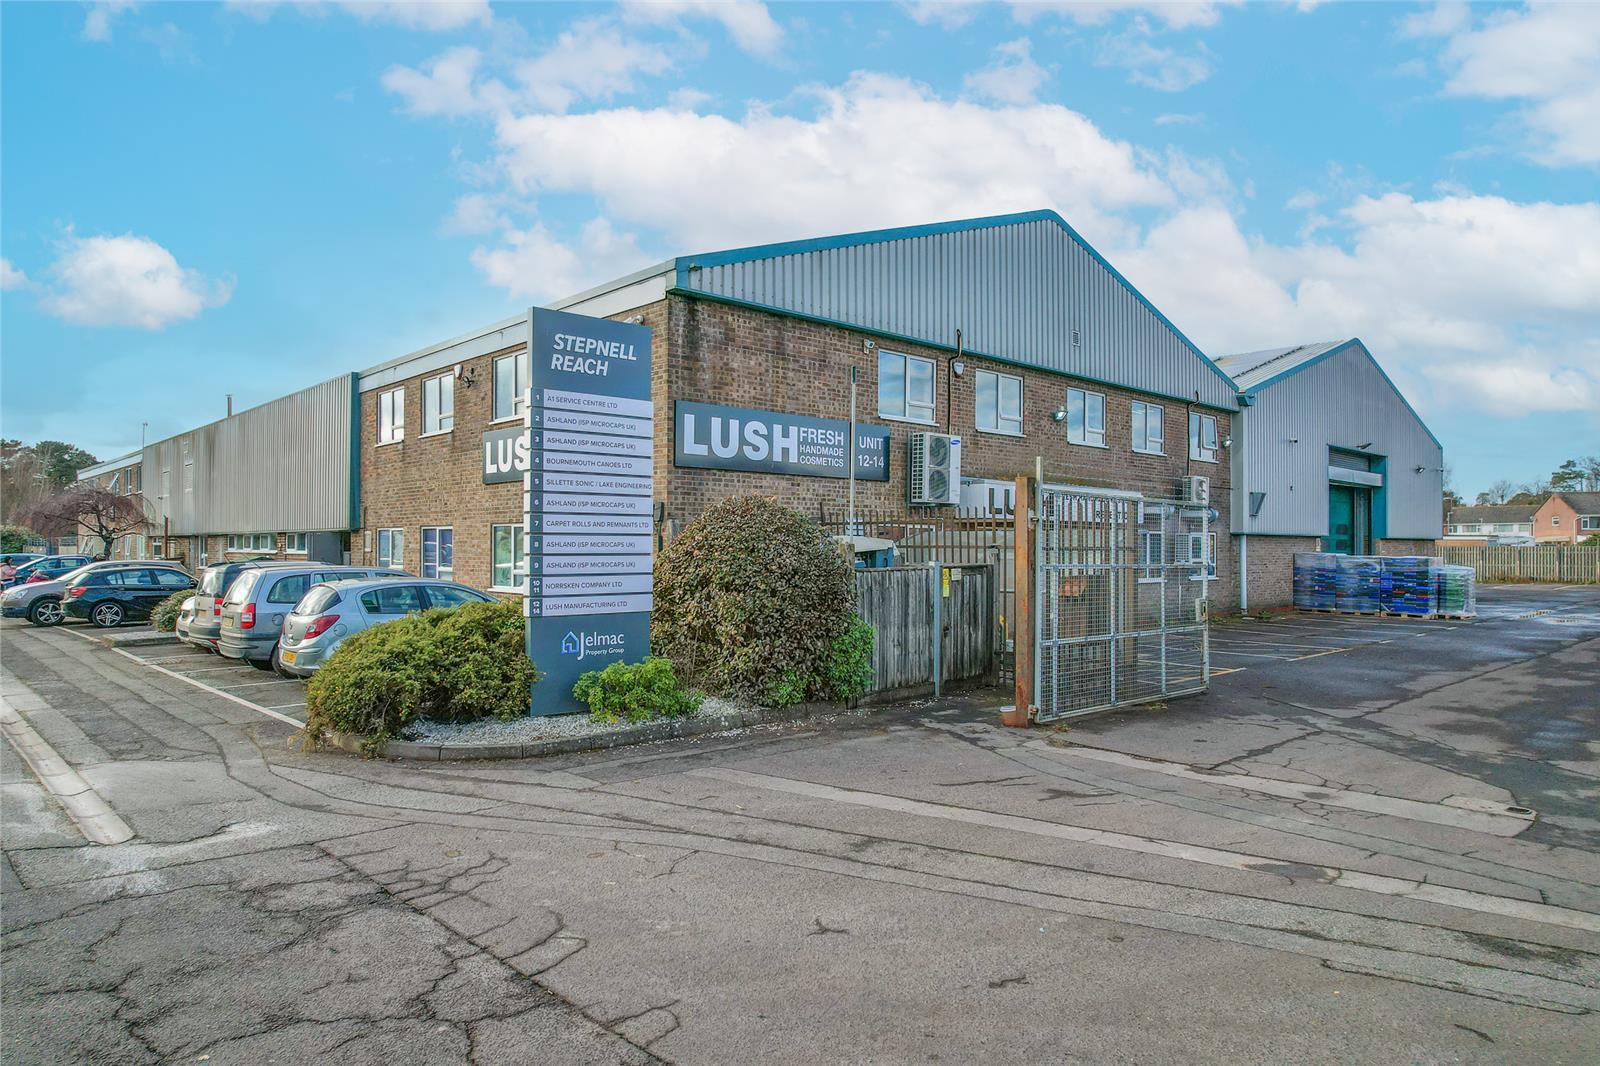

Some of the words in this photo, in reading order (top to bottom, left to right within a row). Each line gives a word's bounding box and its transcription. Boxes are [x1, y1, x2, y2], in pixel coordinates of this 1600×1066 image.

[553, 333, 637, 361] STEPNELL
[551, 354, 608, 376] REACH
[555, 396, 582, 405] SERVICE
[582, 399, 606, 408] CENTRE
[547, 416, 577, 424] ASHLAND
[590, 420, 626, 430] MICROCAPS
[547, 436, 577, 445] ASHLAND
[590, 440, 625, 449] MICROCAPS
[683, 413, 798, 463] LUSH
[800, 427, 844, 446] FRESH
[859, 436, 884, 450] UNIT
[800, 445, 844, 457] HANDMADE
[546, 458, 595, 467] BOURNEMOUTH
[799, 456, 844, 468] COSMETICS
[858, 454, 884, 469] 12-14
[577, 631, 625, 661] Jelmac
